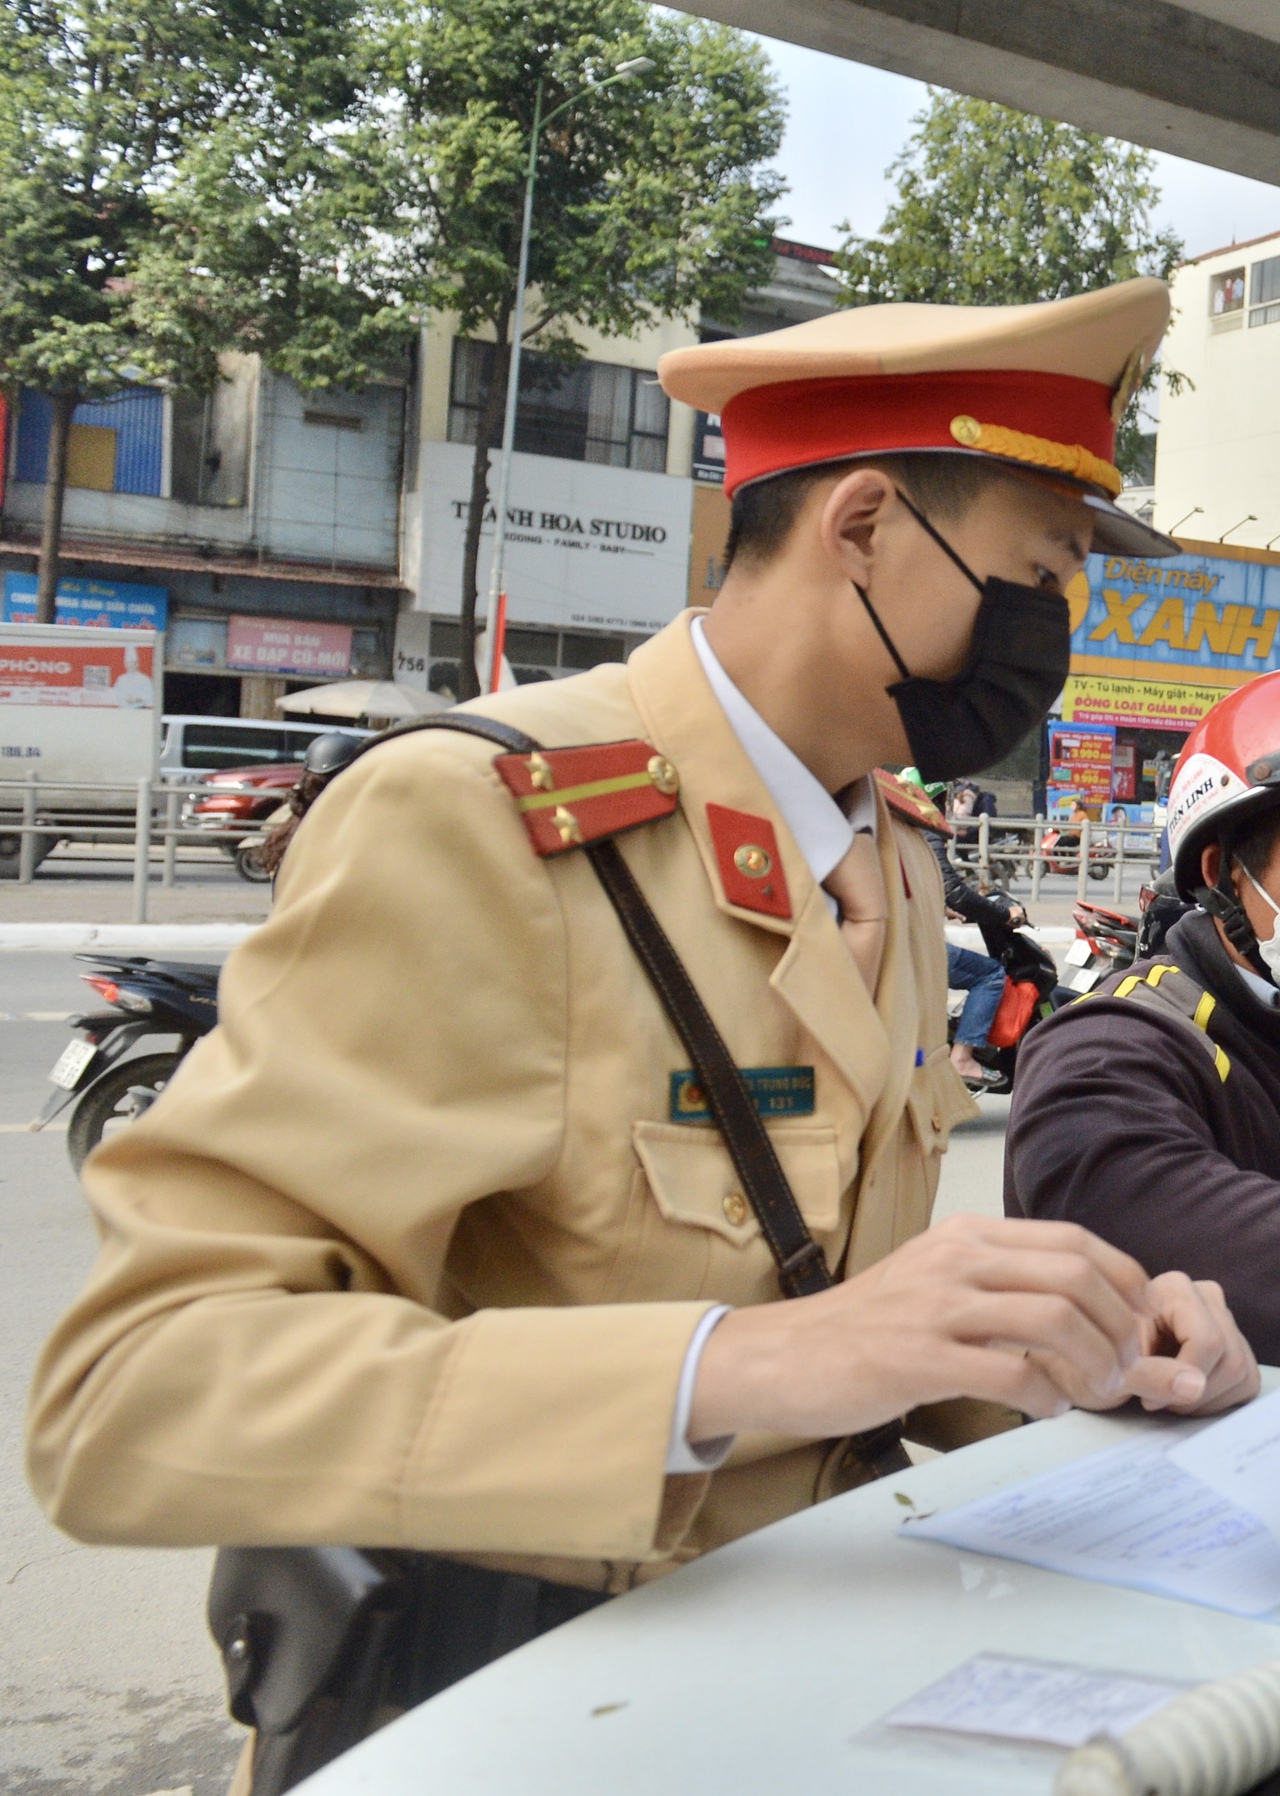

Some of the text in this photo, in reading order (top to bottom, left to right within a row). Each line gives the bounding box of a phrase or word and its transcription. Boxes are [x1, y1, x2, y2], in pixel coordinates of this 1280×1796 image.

[451, 502, 667, 544] TANH HOA STUDIO
[504, 533, 542, 545] EDDING
[1103, 556, 1220, 596] Điện máy
[1074, 680, 1088, 690] TV
[1111, 682, 1135, 695] lạnh
[1143, 686, 1164, 699] Máy
[1195, 690, 1217, 703] Máy
[1075, 693, 1111, 709] ĐỒNG
[1114, 700, 1143, 715] LOẠT
[1180, 703, 1203, 716] ĐẾN
[1185, 777, 1214, 810] LINH
